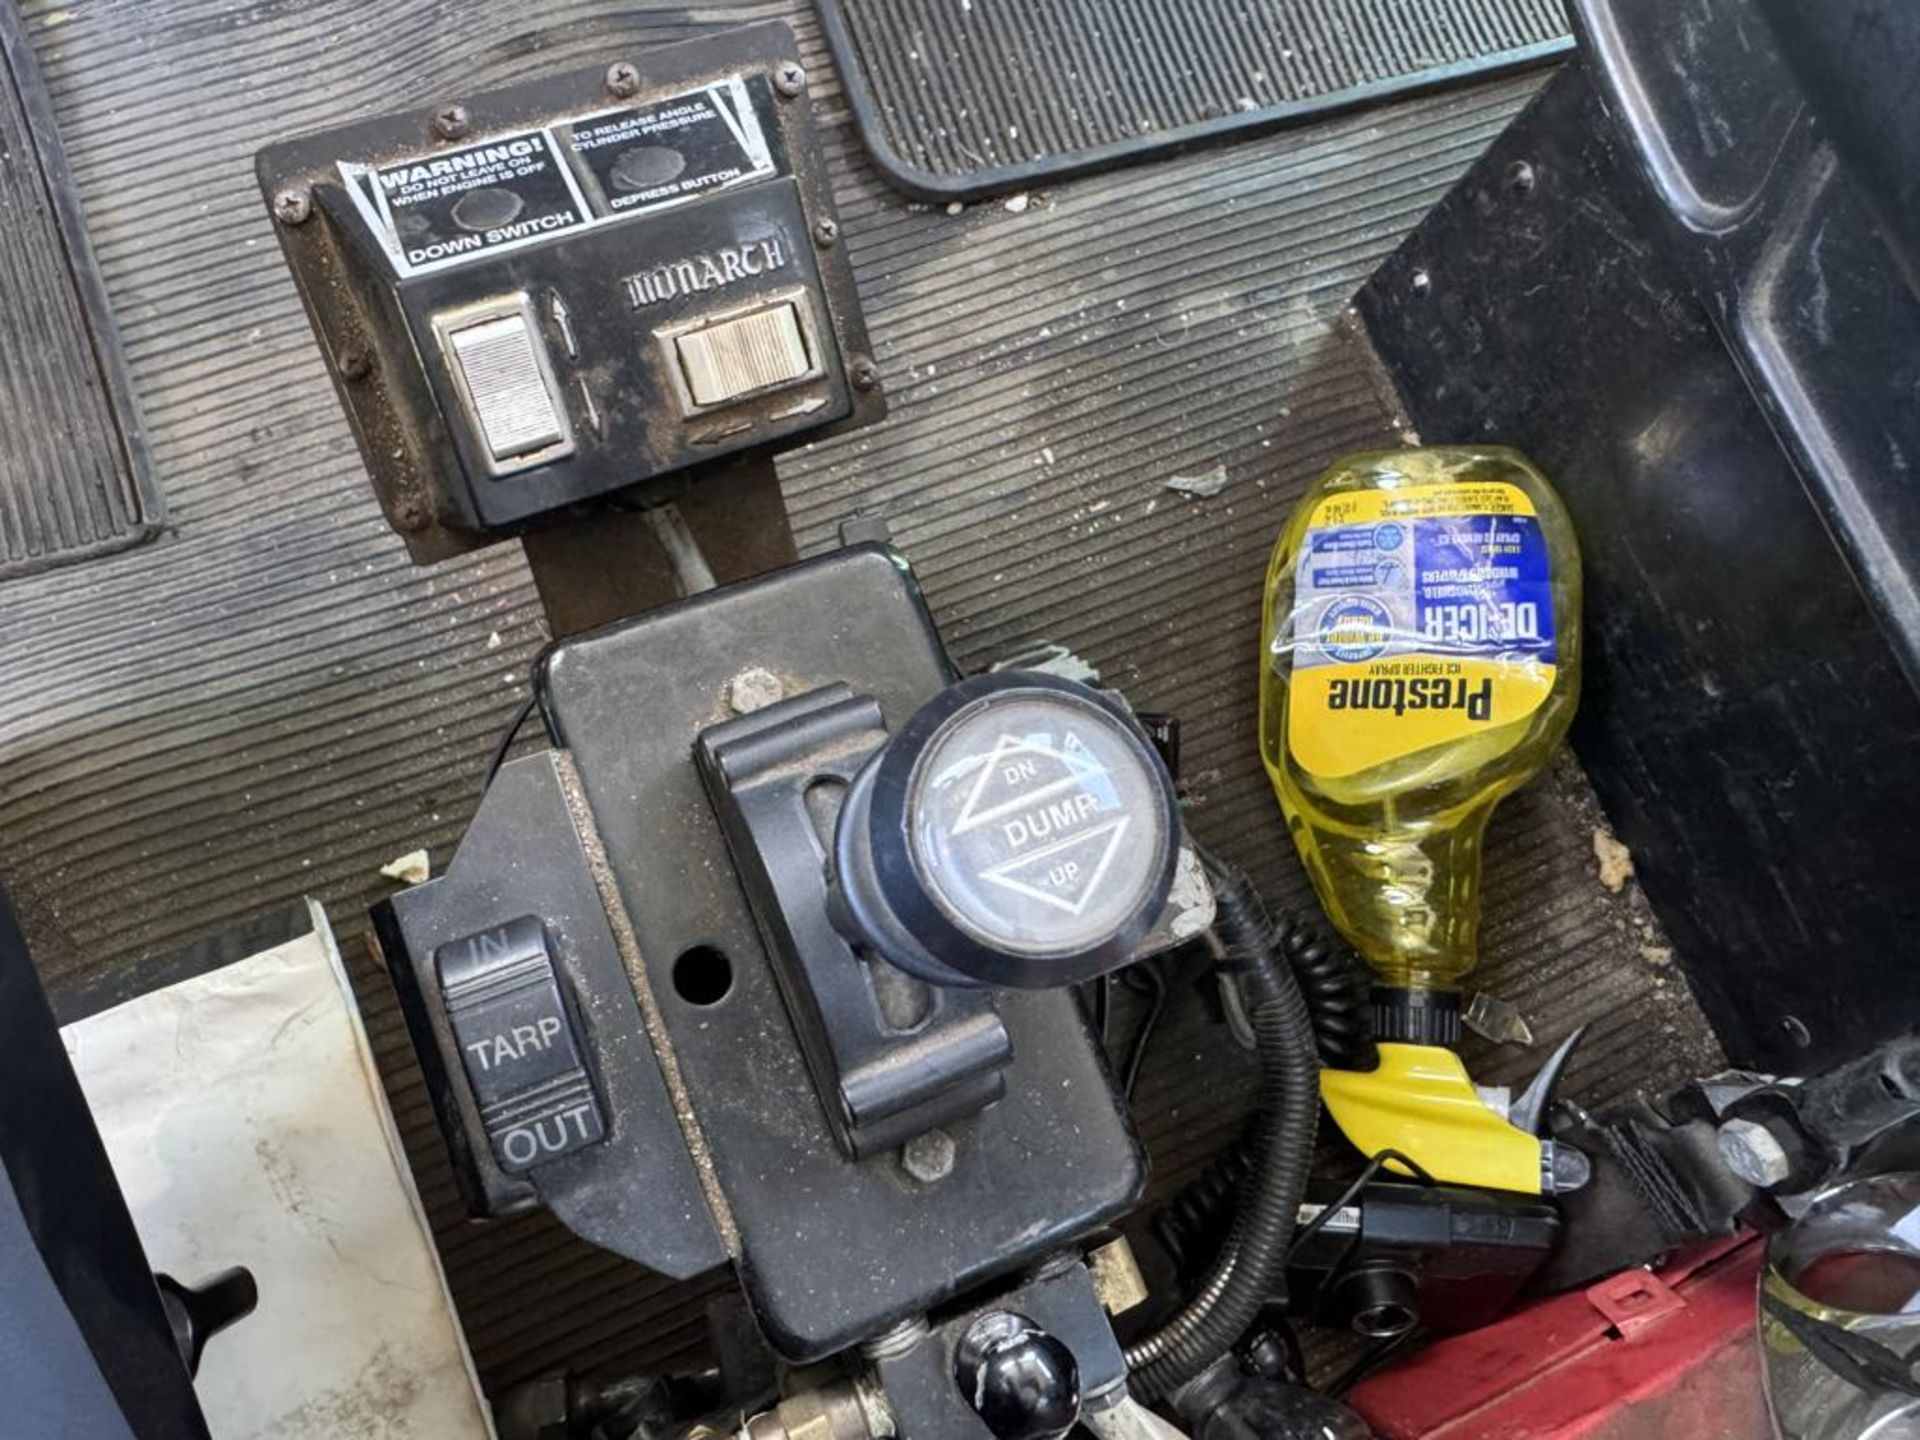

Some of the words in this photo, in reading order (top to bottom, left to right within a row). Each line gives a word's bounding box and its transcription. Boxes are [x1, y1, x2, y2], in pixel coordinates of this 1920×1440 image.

[571, 130, 641, 151] CYLINDER
[643, 110, 718, 135] PRESSURE
[572, 131, 592, 142] TO
[594, 114, 658, 135] RELEASE
[659, 103, 706, 120] ANGLE
[380, 137, 545, 190] WARNING!
[400, 182, 424, 195] DO
[426, 174, 457, 188] NOT
[461, 163, 506, 180] LEAVE
[508, 155, 532, 168] ON
[391, 190, 440, 208] WHEN
[442, 175, 498, 195] ENGINE
[500, 170, 515, 181] IS
[517, 162, 546, 176] OFF
[610, 183, 680, 209] DEPRESS
[682, 168, 742, 190] BUTTON
[409, 234, 483, 264] DOWN
[486, 211, 575, 244] SWITCH
[622, 238, 785, 307] MONARCH
[1368, 663, 1401, 676] SPRAY
[1402, 663, 1444, 675] FIGHTER
[1446, 662, 1461, 674] ICE
[1328, 678, 1492, 721] Prestone
[1003, 759, 1037, 785] DN
[1003, 792, 1099, 848] DUMP
[1048, 861, 1080, 887] UP
[468, 928, 509, 967] IN
[467, 1017, 562, 1071] TARP
[503, 1104, 590, 1164] OUT
